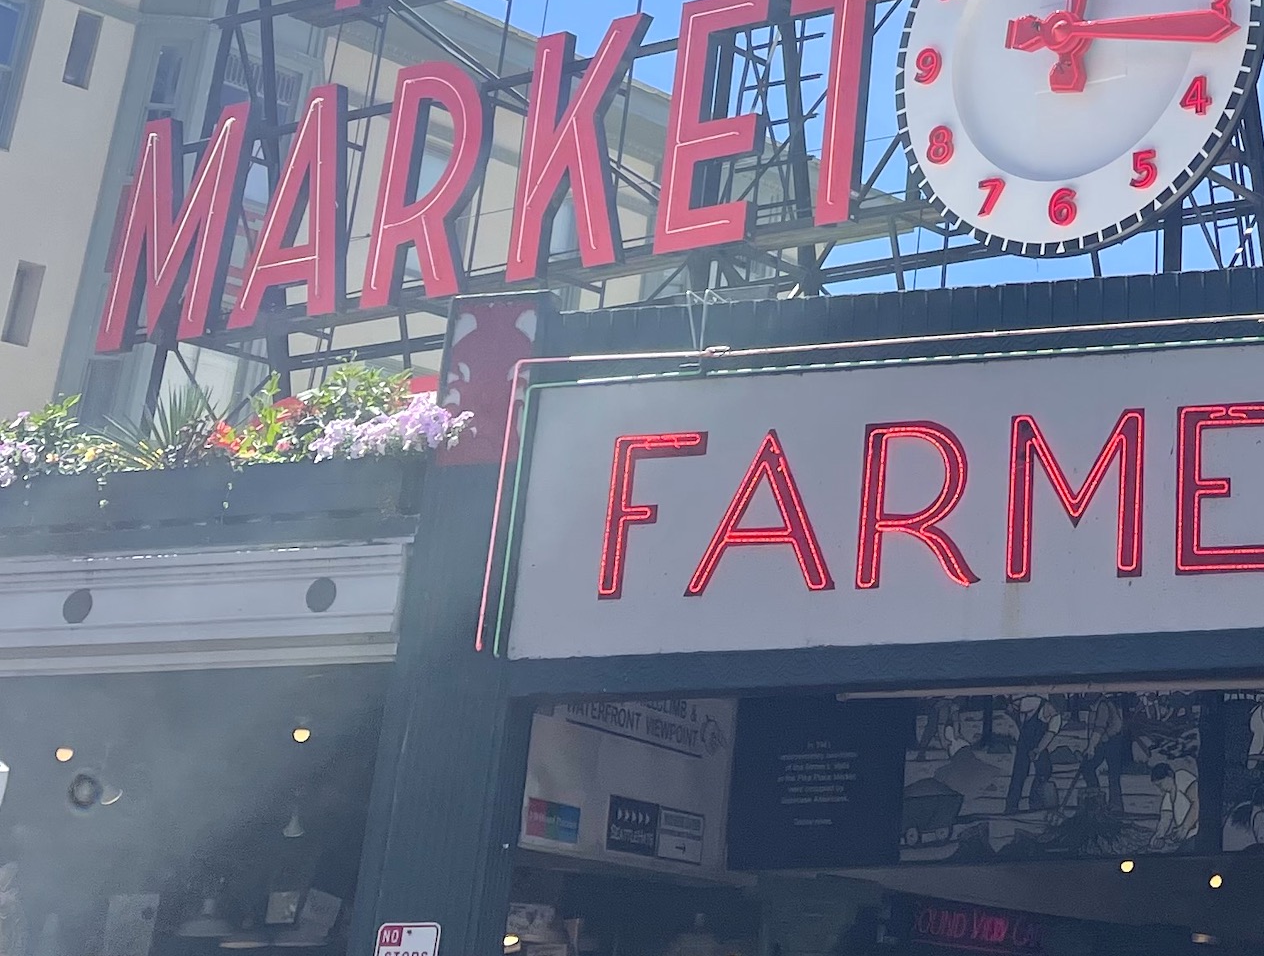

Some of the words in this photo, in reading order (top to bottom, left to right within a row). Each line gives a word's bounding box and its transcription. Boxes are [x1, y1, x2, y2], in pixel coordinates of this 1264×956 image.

[914, 47, 943, 85] 9
[1179, 74, 1213, 116] 4
[926, 124, 954, 165] 8
[1129, 148, 1158, 189] 5
[977, 177, 1005, 218] 7
[1047, 187, 1078, 226] 6
[381, 929, 399, 944] NO
